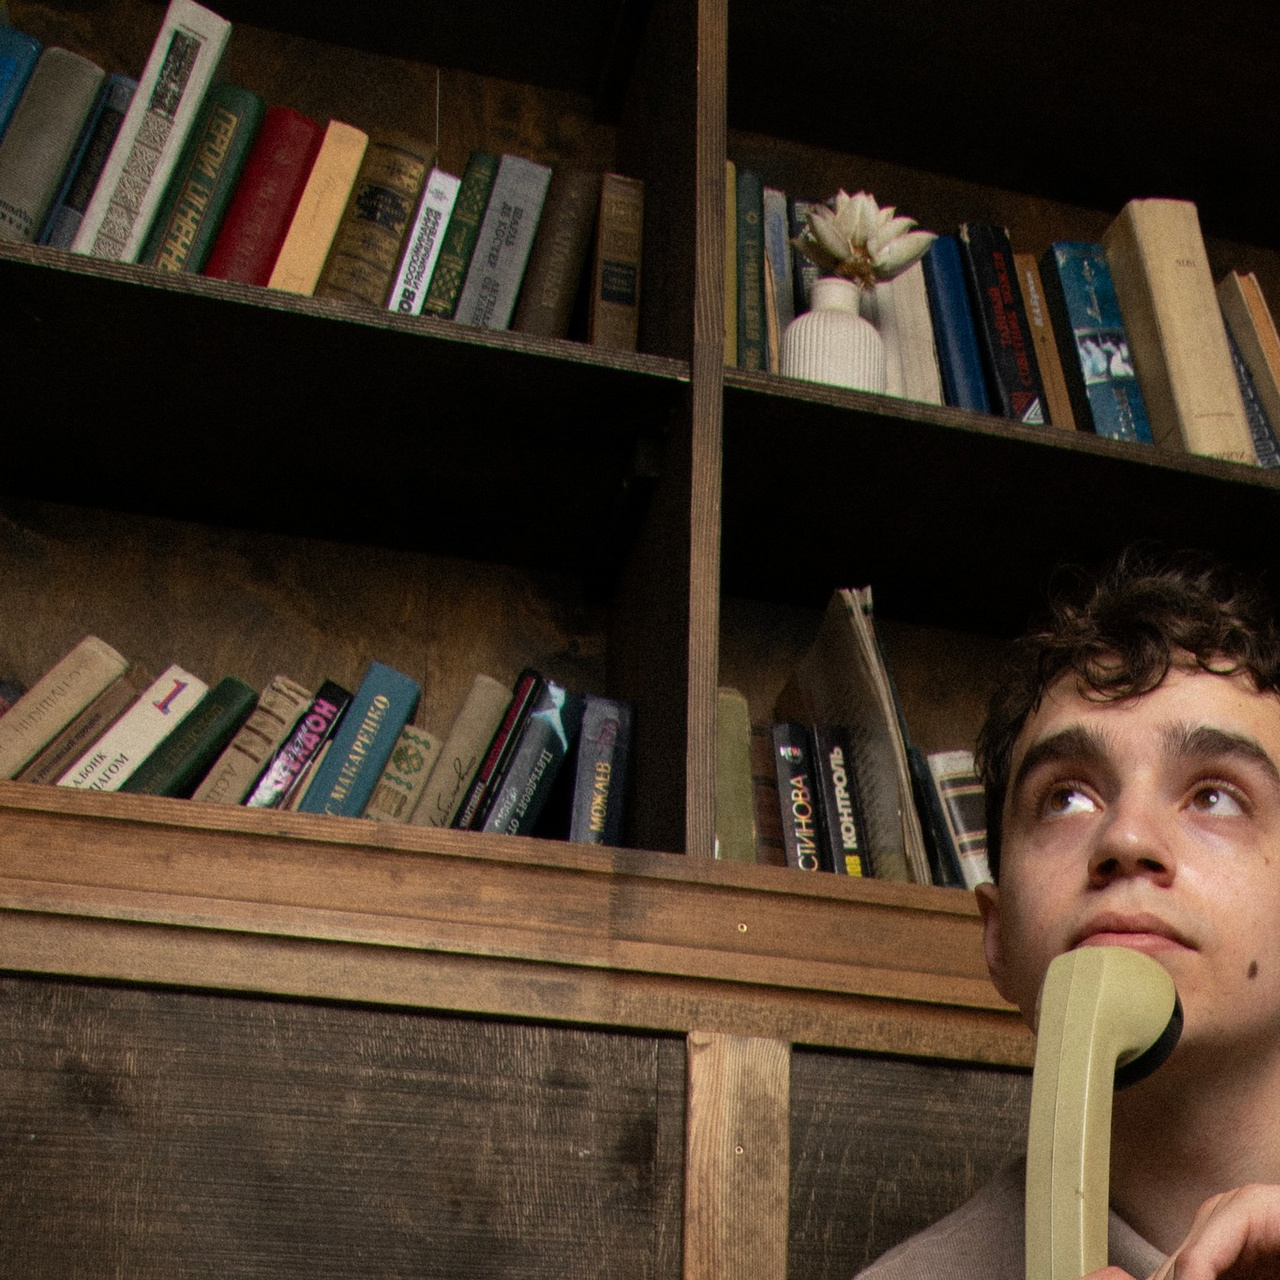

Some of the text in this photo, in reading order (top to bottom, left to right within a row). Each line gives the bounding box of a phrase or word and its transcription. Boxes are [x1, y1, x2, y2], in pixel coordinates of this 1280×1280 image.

[398, 290, 416, 315] ОВ
[152, 678, 189, 716] 1
[329, 693, 391, 801] МАКАРЕНКО
[588, 760, 612, 833] МОЖАЕВ
[790, 774, 818, 872] СТИНОВА
[829, 746, 858, 850] КОНТРОЛЬ
